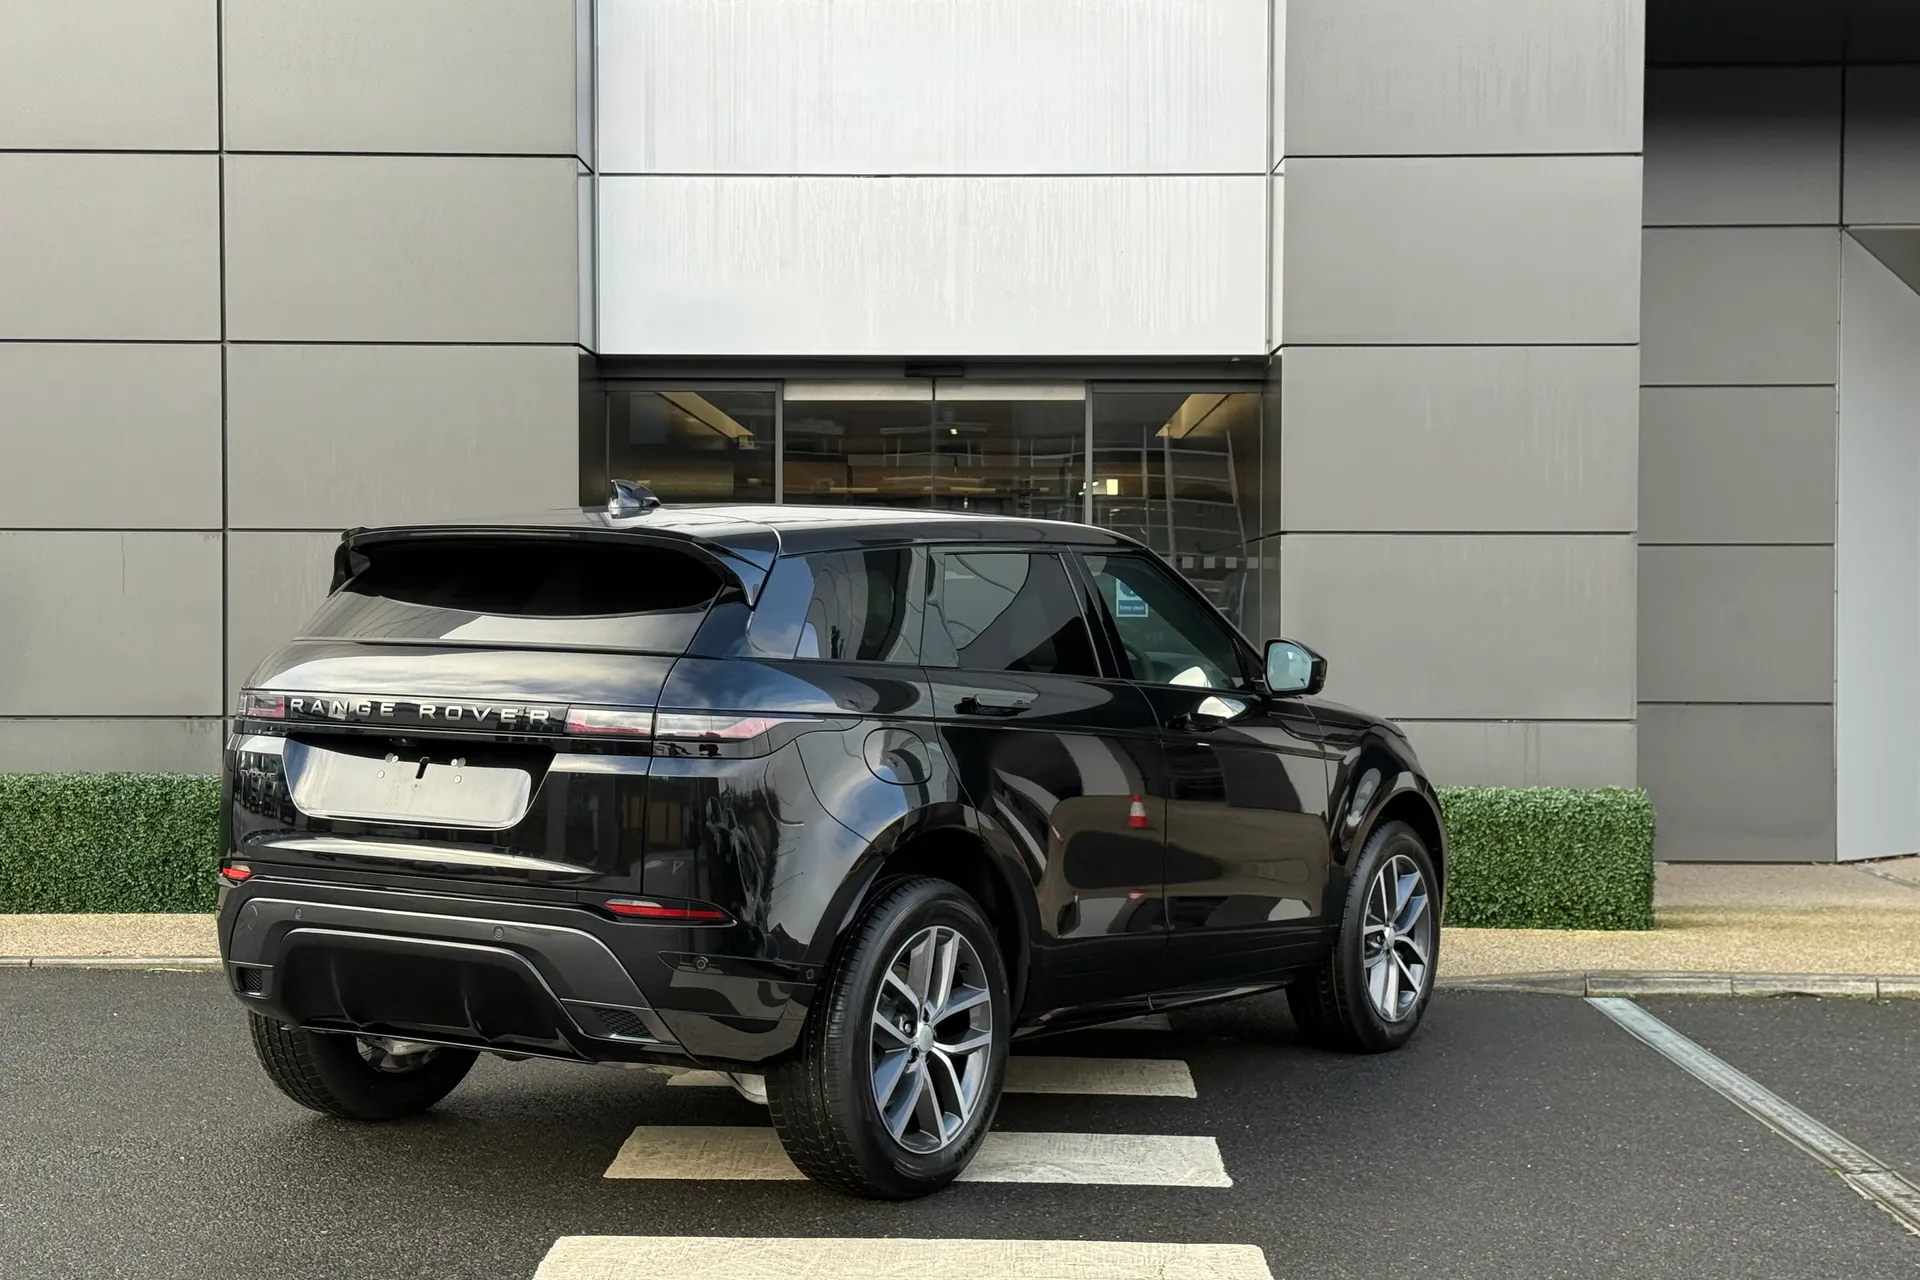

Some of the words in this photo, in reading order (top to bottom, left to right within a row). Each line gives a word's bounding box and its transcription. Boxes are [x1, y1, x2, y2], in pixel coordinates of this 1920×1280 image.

[290, 698, 396, 717] RANGE
[419, 704, 550, 725] ROVER
[240, 769, 277, 780] EVOQUE
